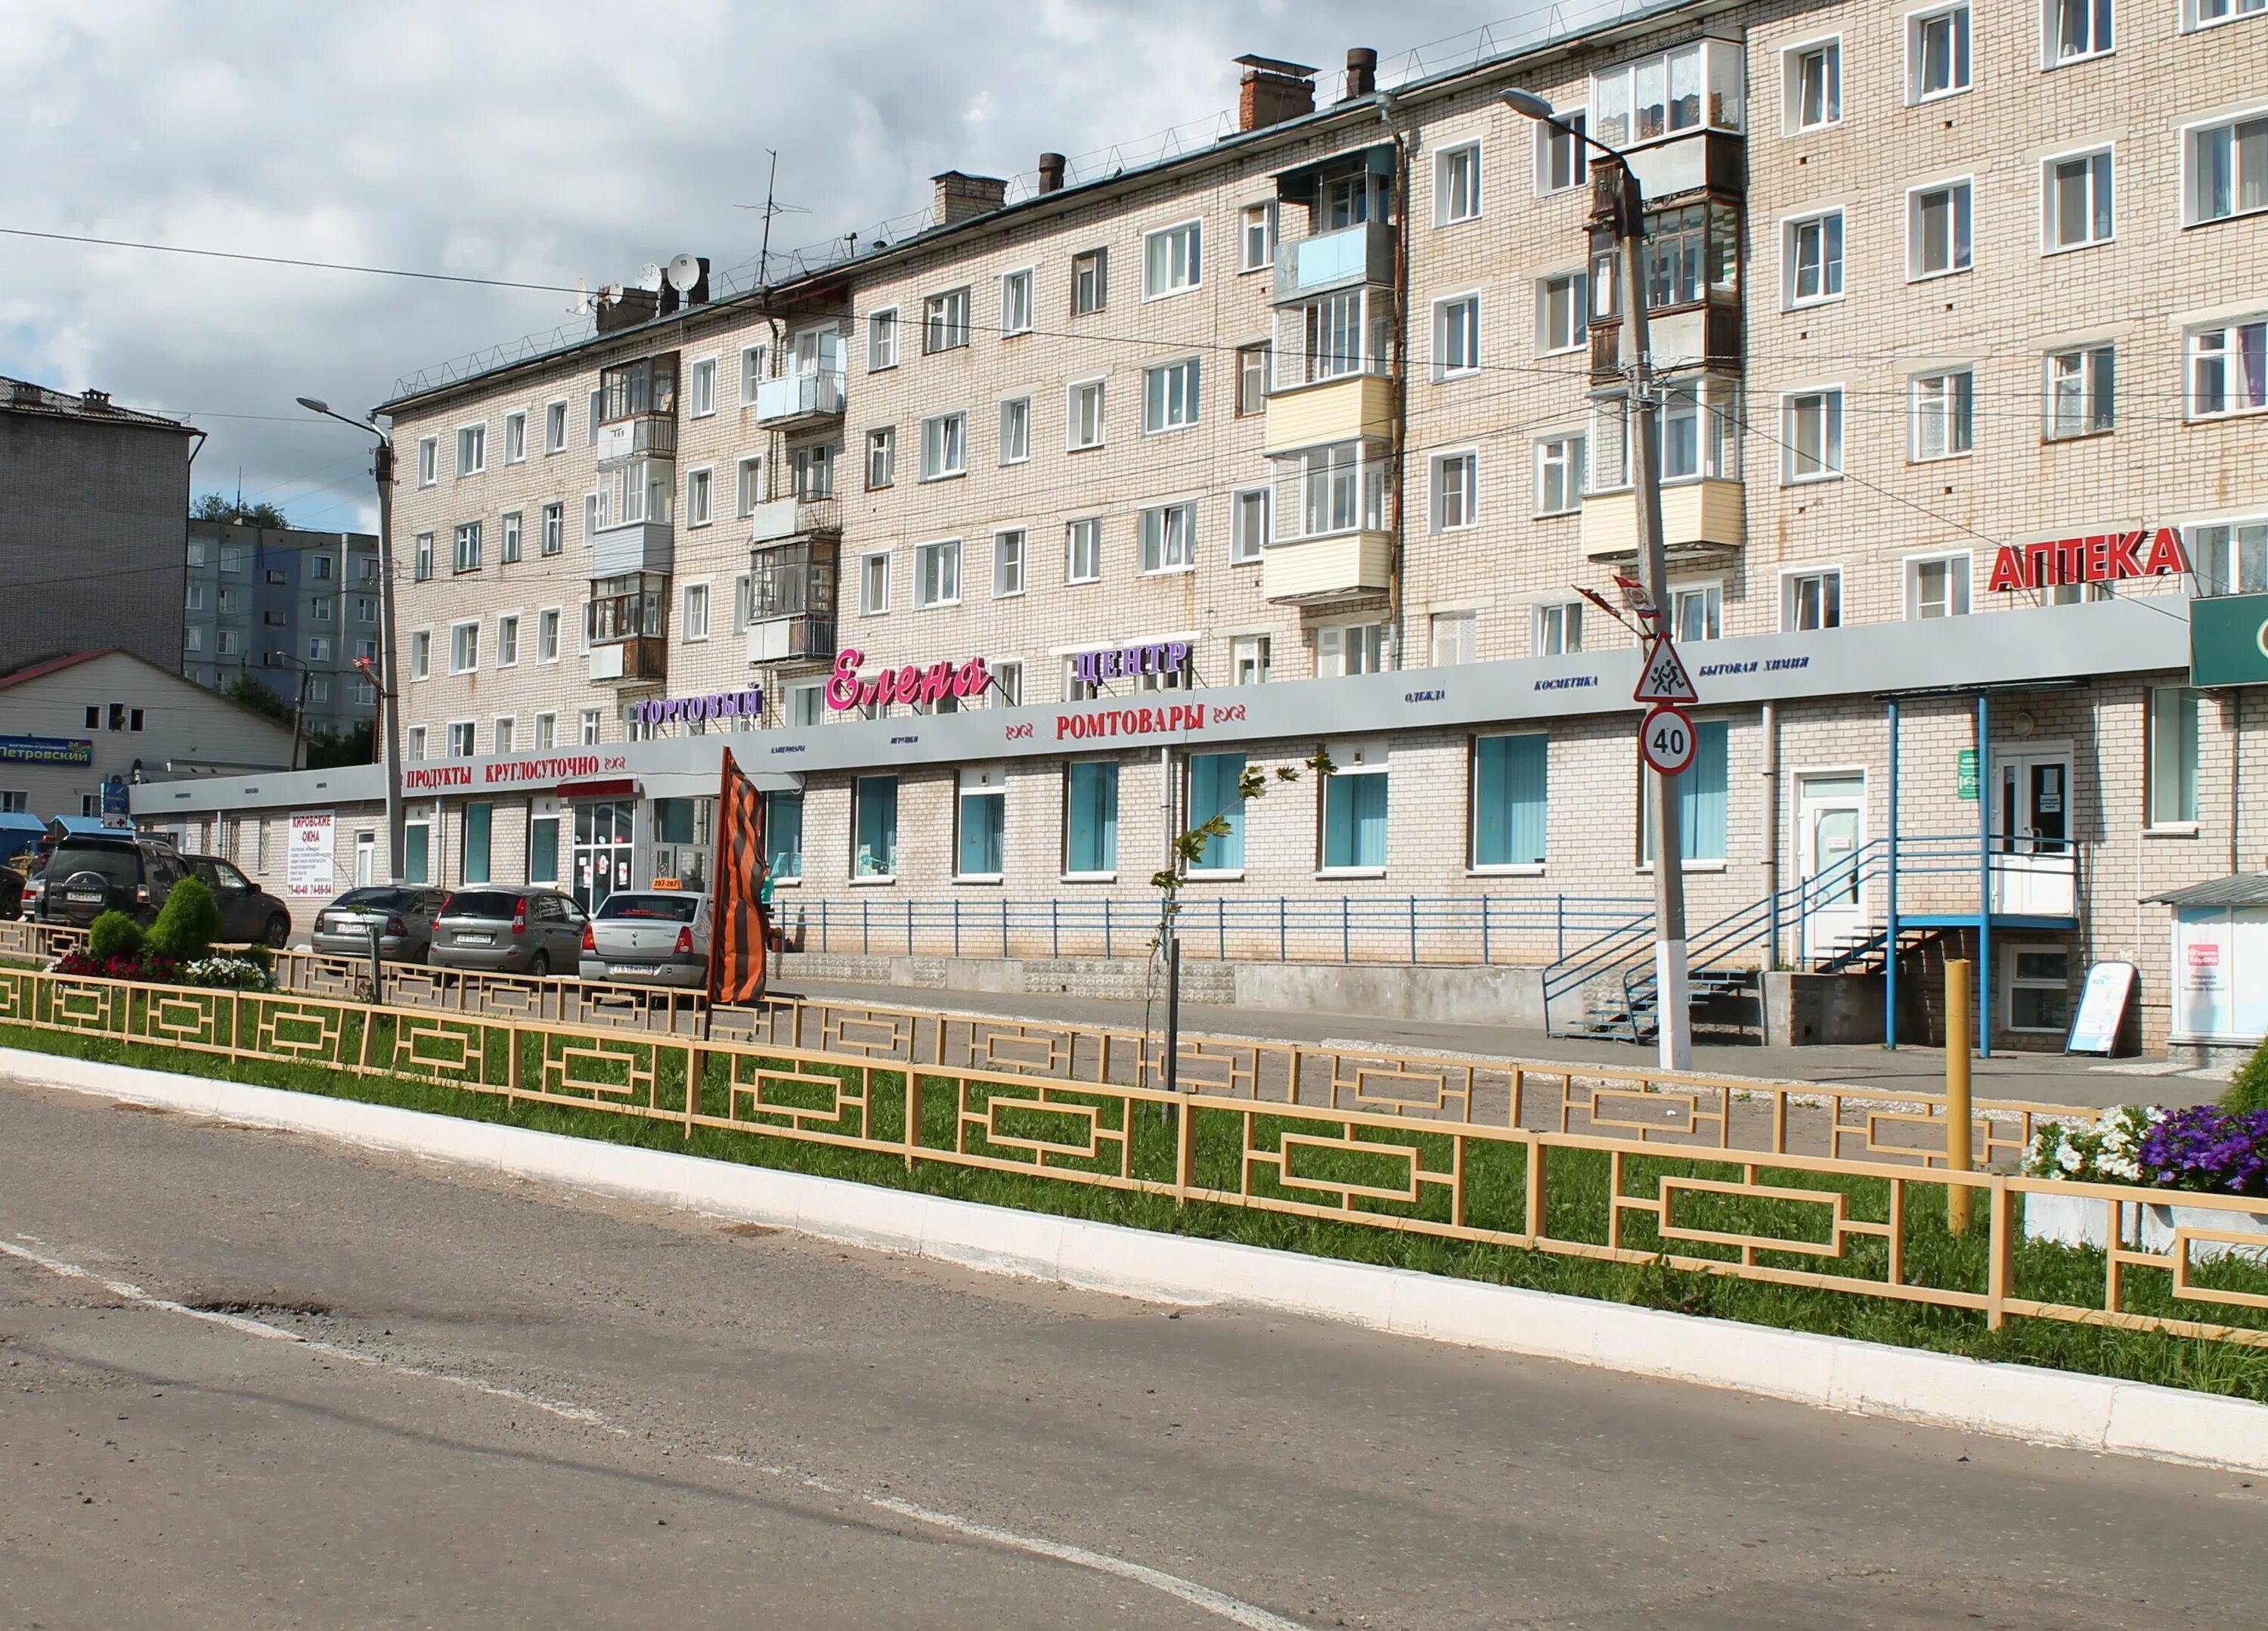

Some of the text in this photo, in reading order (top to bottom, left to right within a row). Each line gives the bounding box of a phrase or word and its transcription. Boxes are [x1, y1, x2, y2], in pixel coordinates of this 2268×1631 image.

[1988, 526, 2191, 594] АПТЕКА
[825, 647, 995, 711] Елена
[1076, 640, 1191, 687] ЦЕНТР
[1699, 656, 1810, 678] БЫТОВАЯ ХИМИЯ
[1404, 688, 1446, 703] ОДЕЖДА
[1533, 674, 1599, 692] КОСМЕТИКА
[635, 682, 763, 726] ТОРГОВЫЙ
[1055, 703, 1206, 741] РОМТОВАРЫ
[1653, 727, 1685, 755] 40
[406, 755, 600, 790] ПРОДУКТЫ КРУГЛОСУТОЧНО
[292, 814, 331, 828] КИРОВСКИЕ
[302, 829, 321, 843] ОКНА
